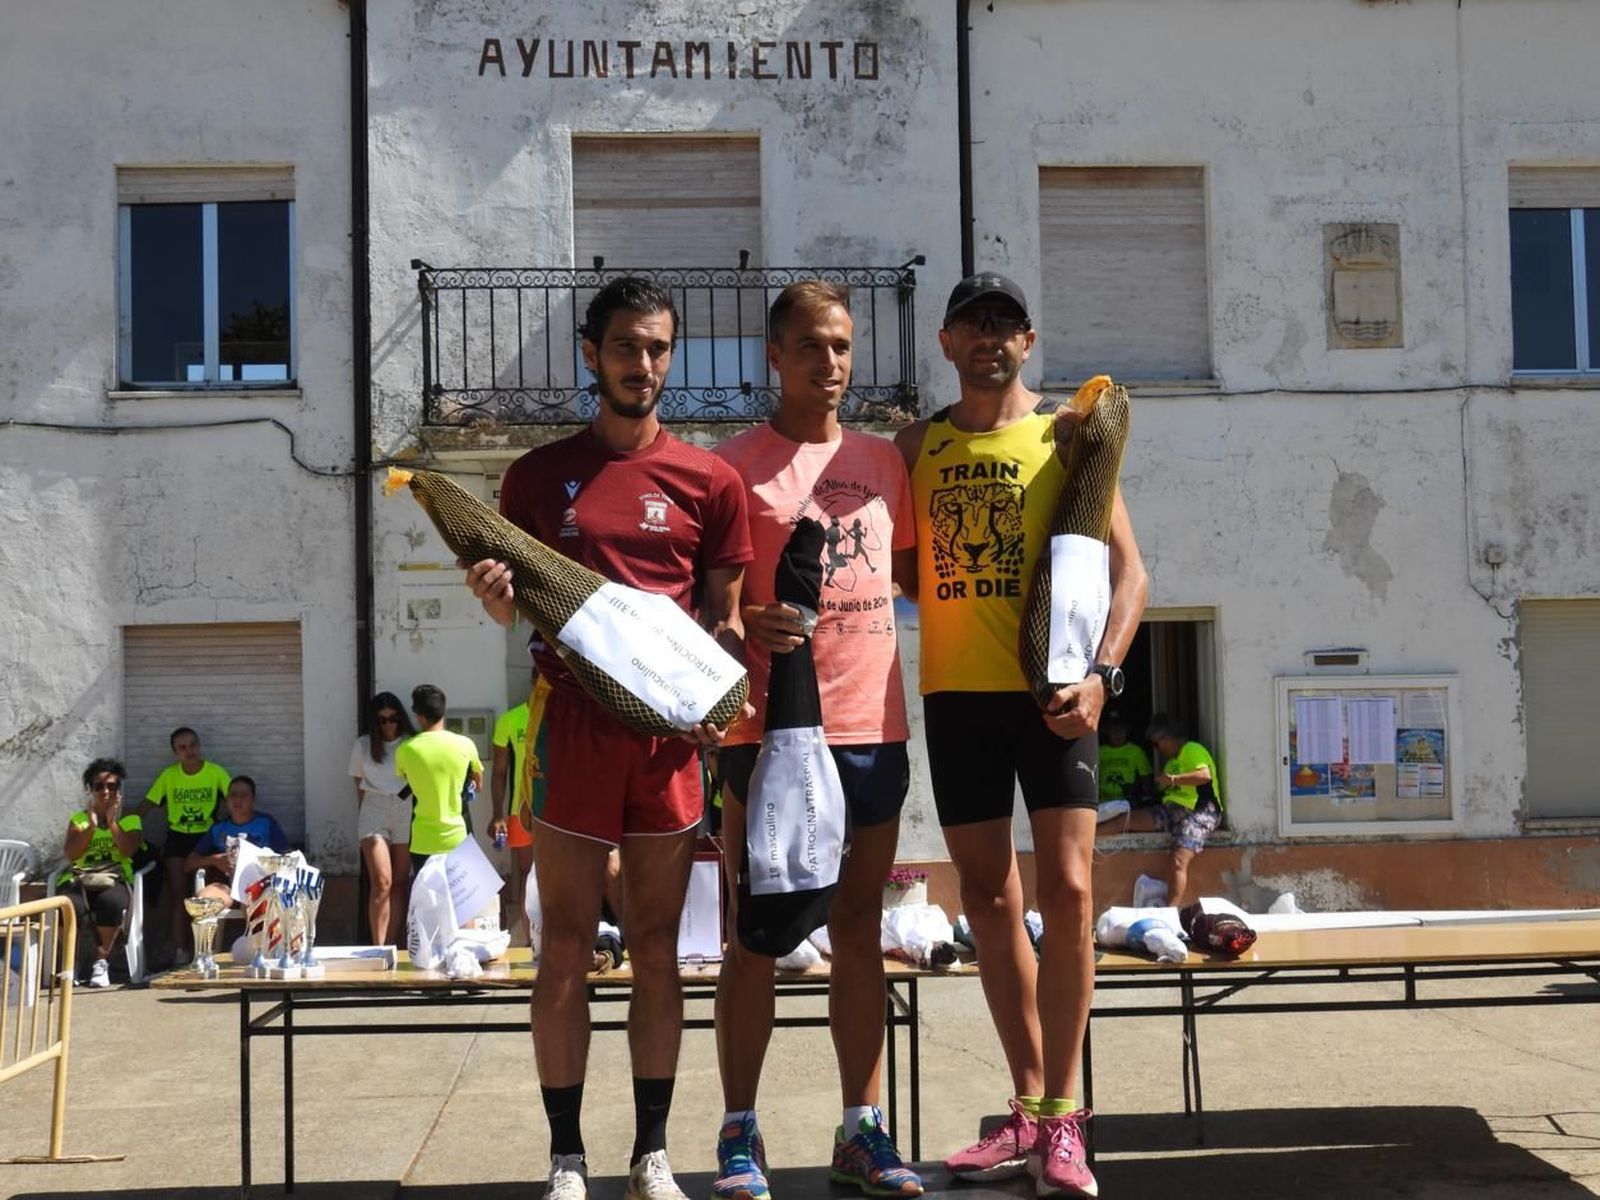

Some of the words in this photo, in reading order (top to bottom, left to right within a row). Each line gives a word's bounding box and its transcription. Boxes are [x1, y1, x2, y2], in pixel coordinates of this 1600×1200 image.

[478, 37, 879, 81] AYUNTAMIENTO
[940, 462, 1019, 484] TRAIN
[826, 600, 837, 611] de
[838, 599, 862, 612] Junio
[862, 600, 873, 611] de
[936, 579, 968, 601] OR
[975, 578, 1022, 598] DIE
[631, 656, 682, 698] masculino
[766, 802, 779, 861] masculino
[805, 806, 819, 873] PATROCINA
